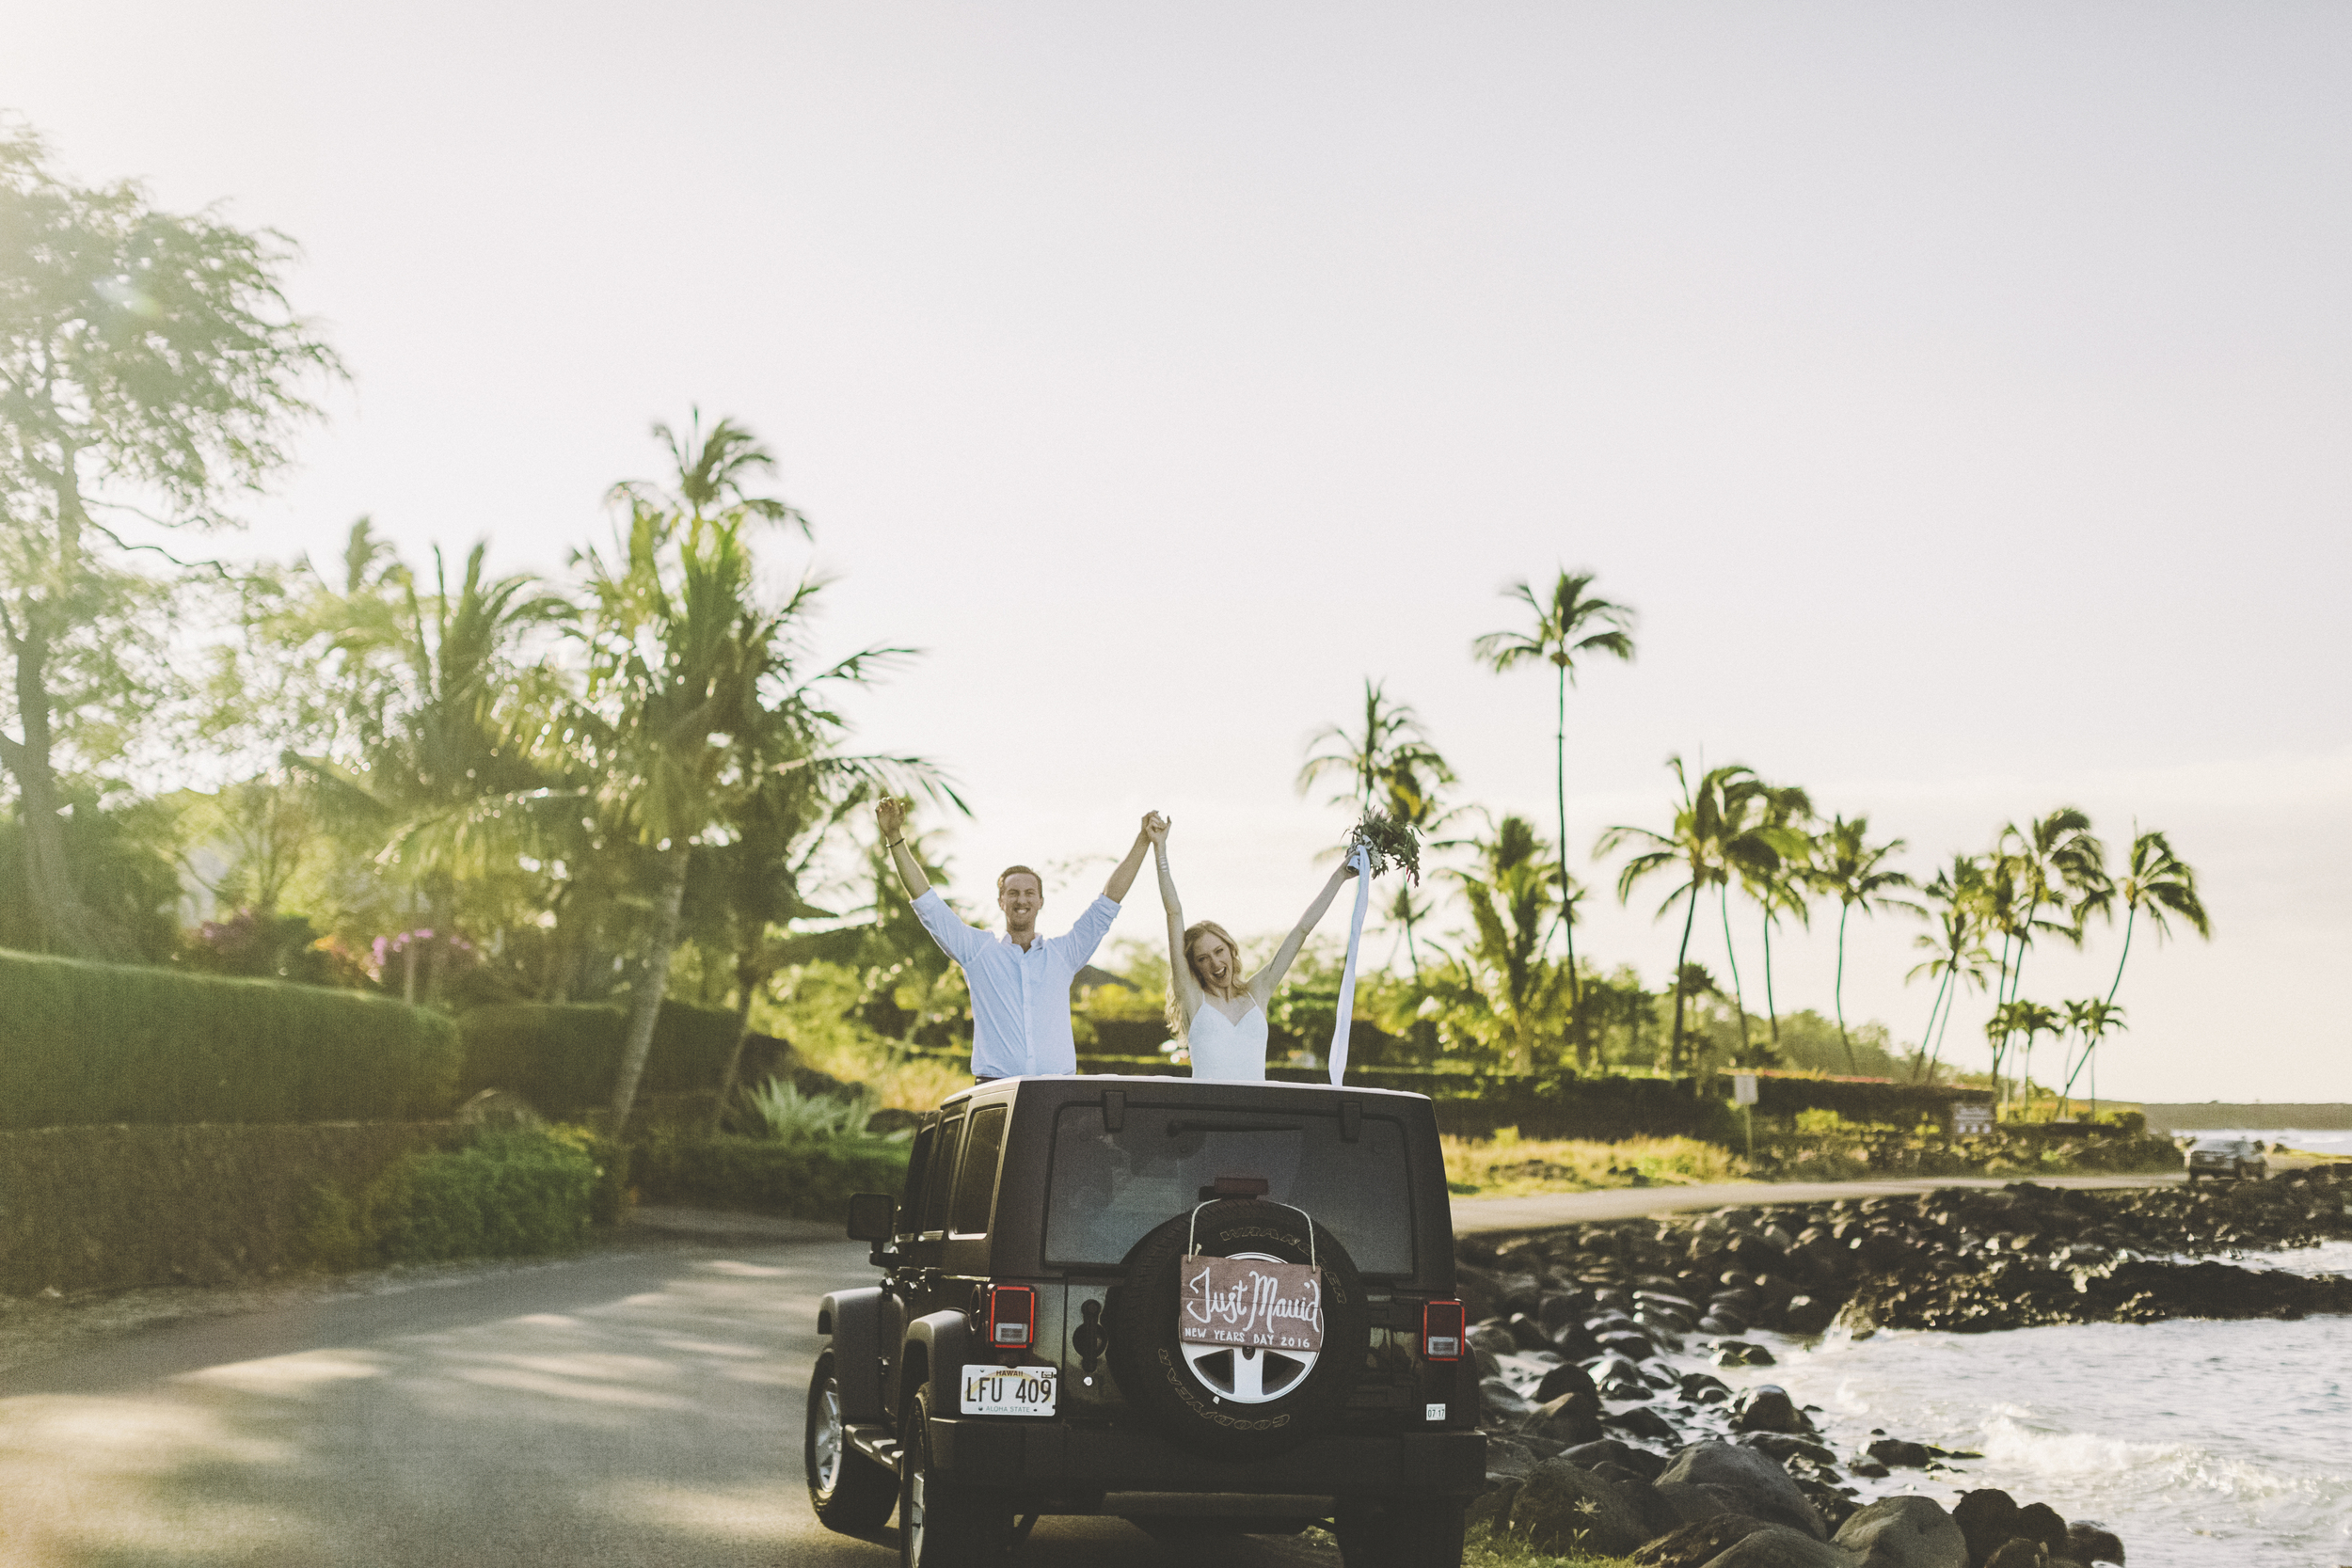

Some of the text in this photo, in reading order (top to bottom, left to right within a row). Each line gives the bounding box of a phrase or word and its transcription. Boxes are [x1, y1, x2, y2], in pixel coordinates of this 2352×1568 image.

[1186, 1266, 1248, 1324] Just
[1184, 1327, 1311, 1349] NEW YEARS DAY 2016
[967, 1377, 1052, 1403] LFU 409
[1157, 1348, 1291, 1431] GOODYEAR
